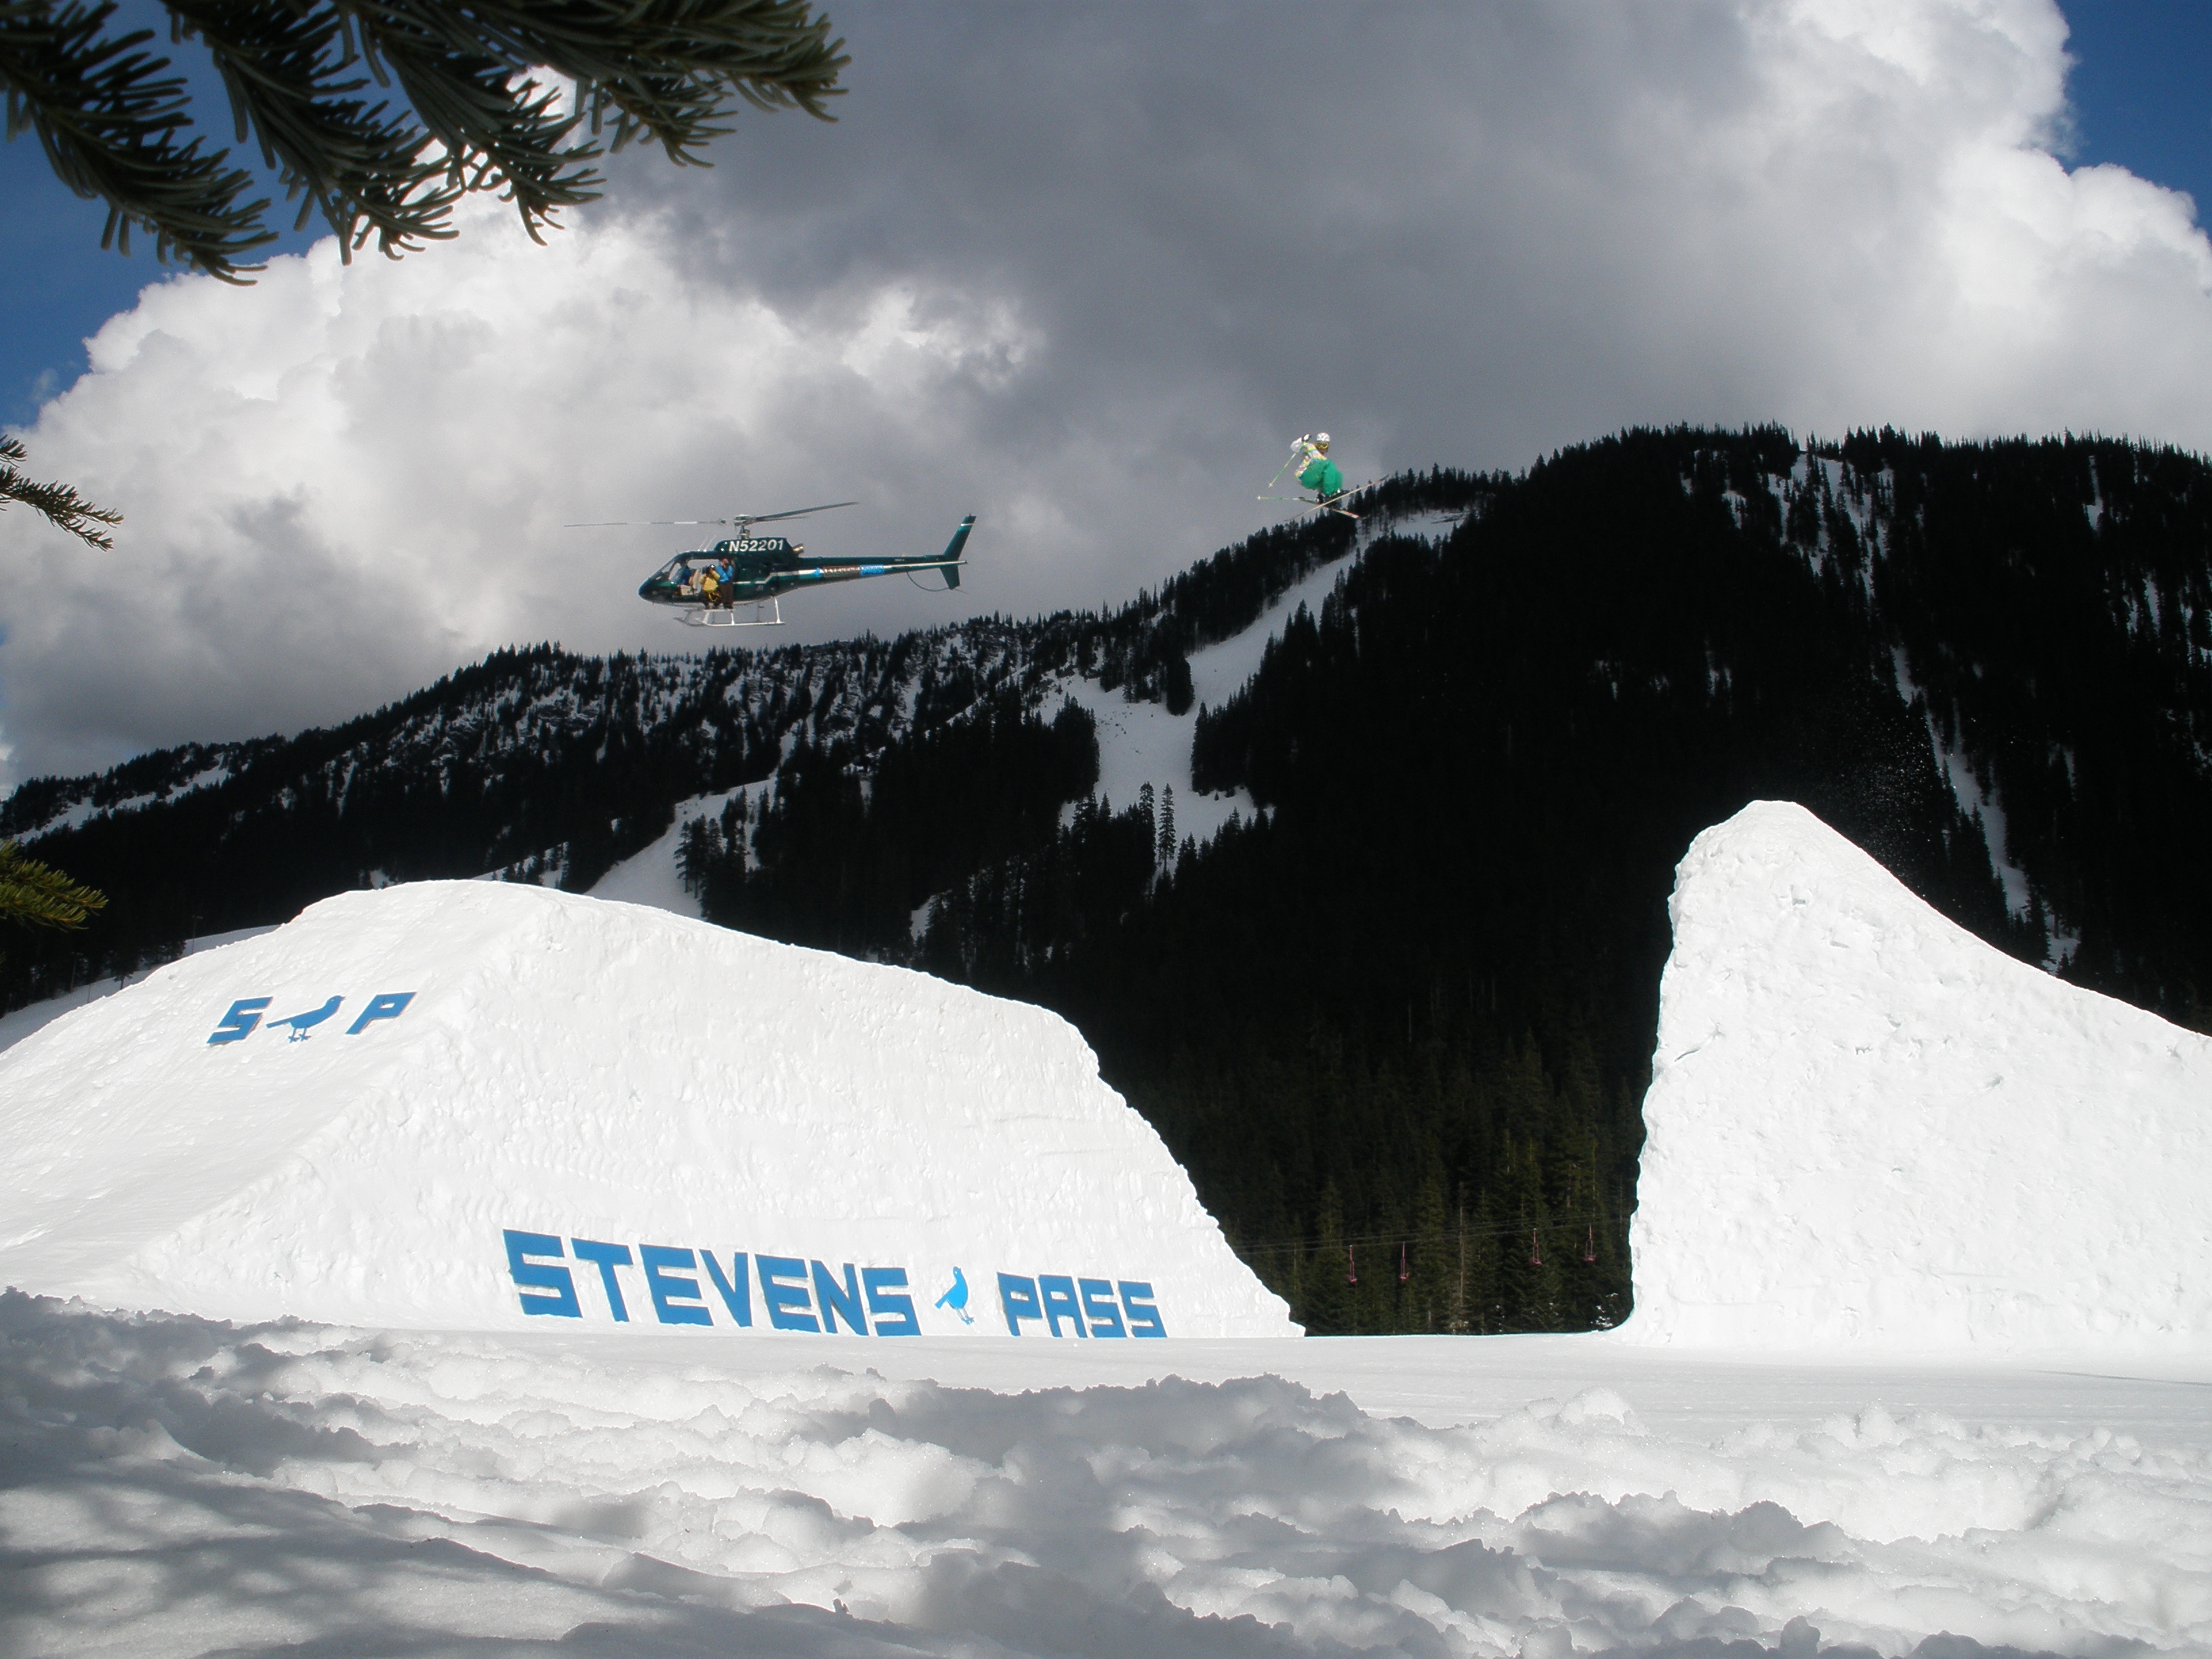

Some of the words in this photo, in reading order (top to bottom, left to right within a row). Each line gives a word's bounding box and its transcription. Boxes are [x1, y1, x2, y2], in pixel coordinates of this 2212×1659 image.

[729, 539, 783, 552] N52201
[207, 997, 272, 1044] S
[346, 992, 416, 1035] P
[503, 1229, 922, 1337] STEVENS
[998, 1272, 1168, 1338] PASS
